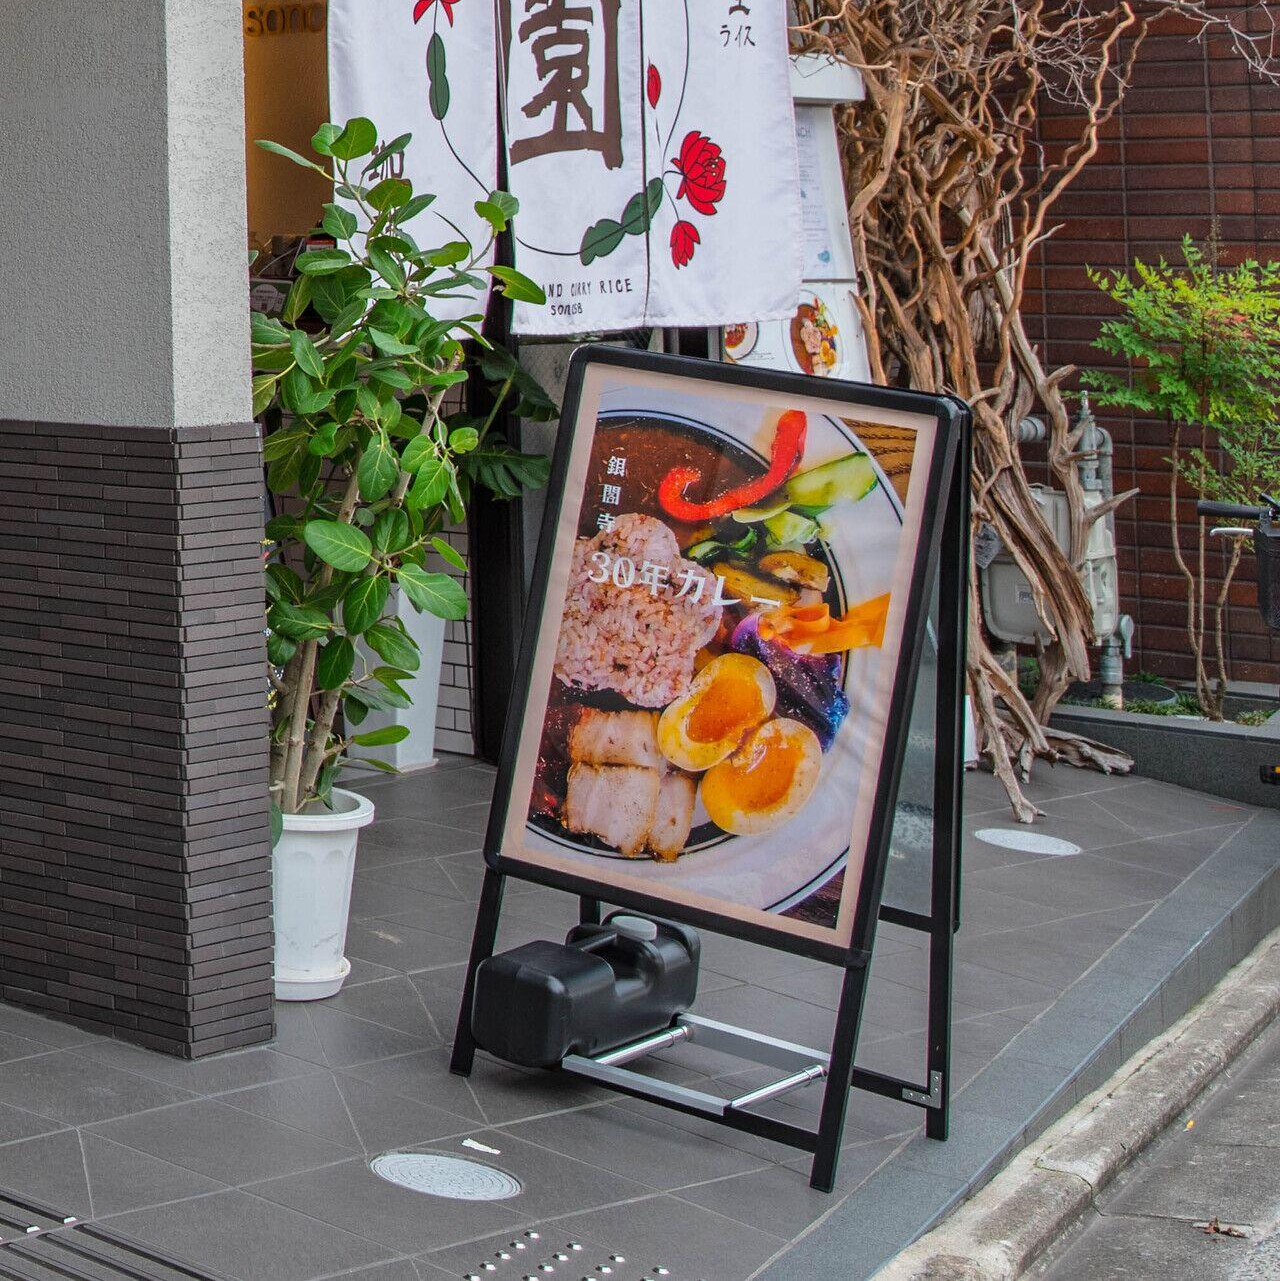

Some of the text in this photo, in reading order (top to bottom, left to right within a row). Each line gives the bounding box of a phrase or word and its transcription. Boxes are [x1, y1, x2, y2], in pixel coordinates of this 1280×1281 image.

[719, 24, 756, 48] ライス
[599, 278, 633, 294] RICE
[596, 455, 627, 534] 銀閣寺
[588, 551, 782, 608] 30年カレー
